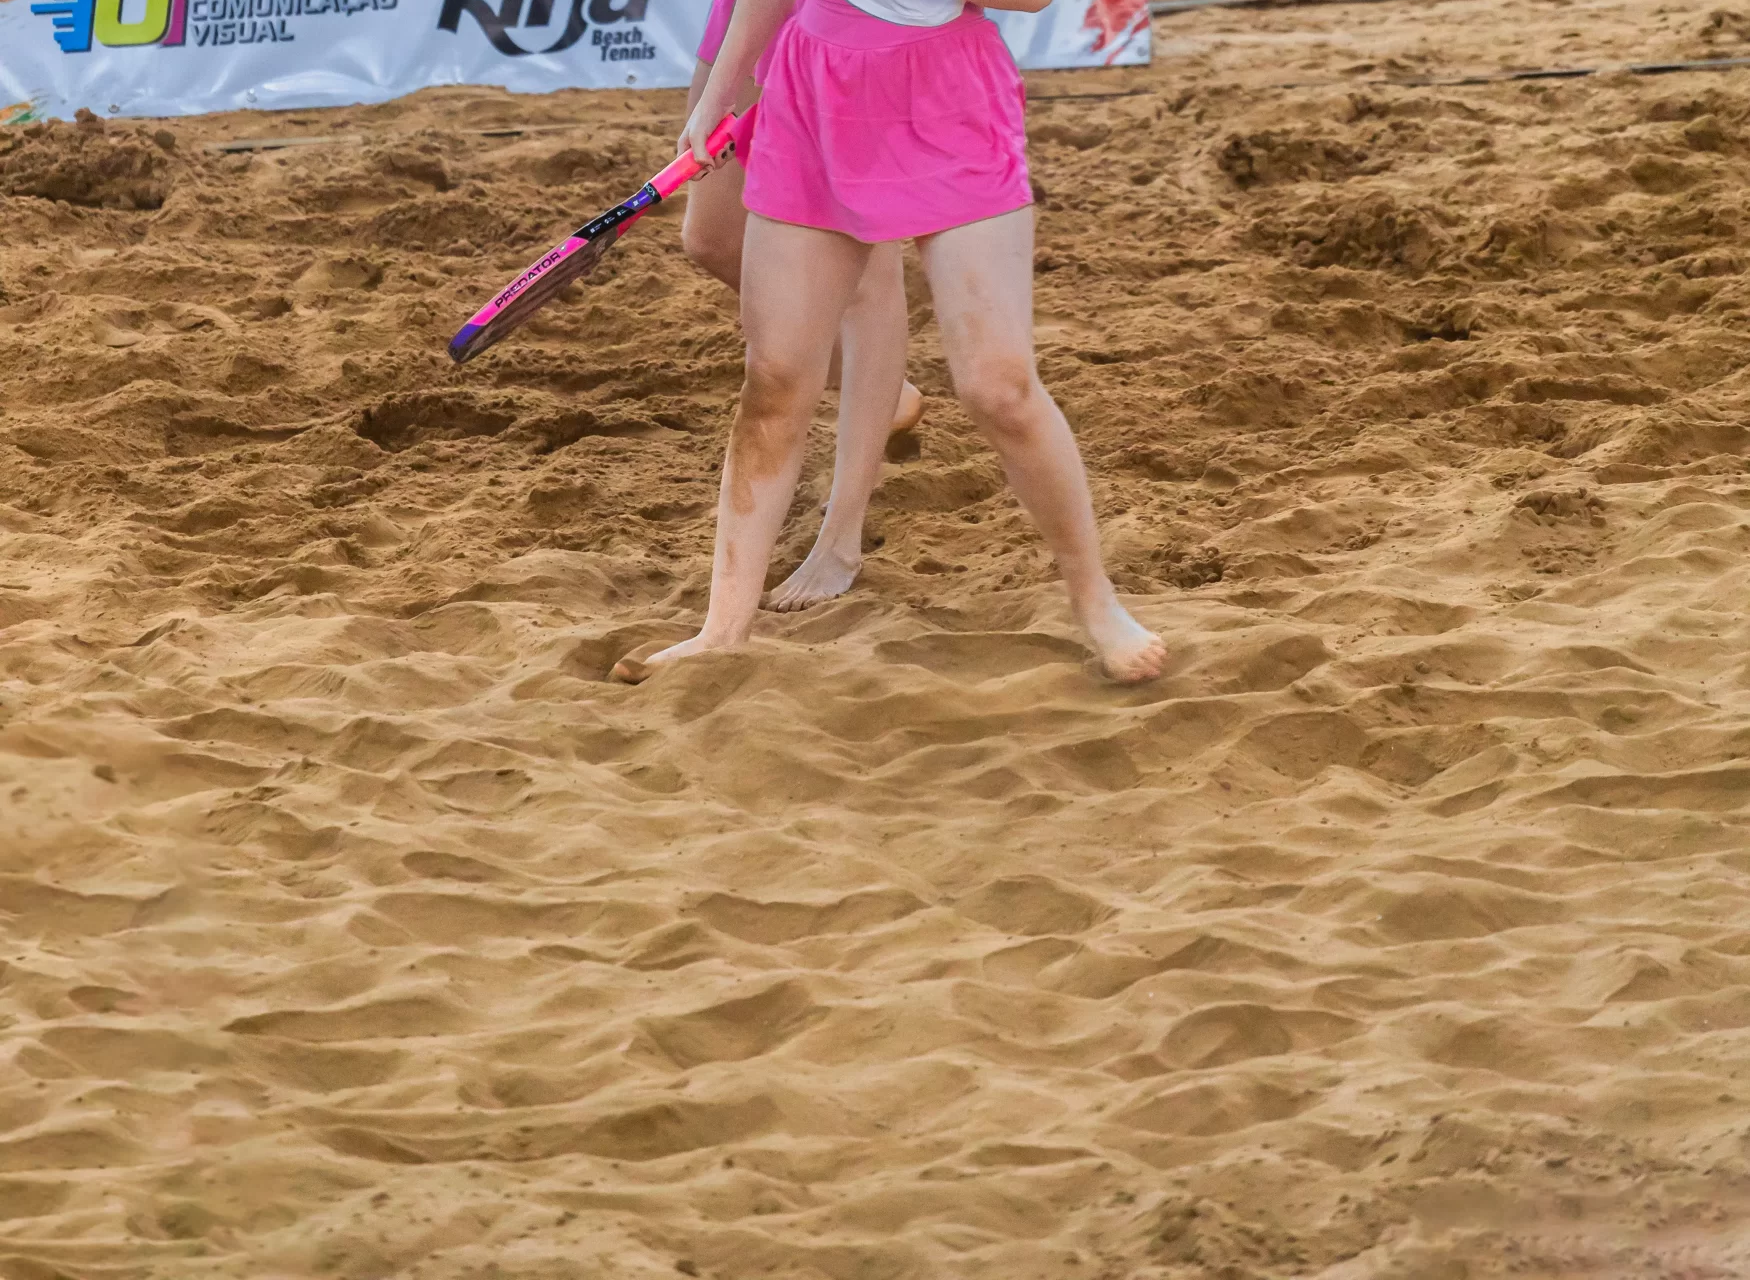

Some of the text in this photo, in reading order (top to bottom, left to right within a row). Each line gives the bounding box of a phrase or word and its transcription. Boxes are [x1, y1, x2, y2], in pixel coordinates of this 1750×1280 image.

[188, 18, 295, 47] VISUAL
[591, 26, 643, 46] Beach
[600, 42, 656, 62] Tennis
[494, 251, 561, 309] PREDATOR
